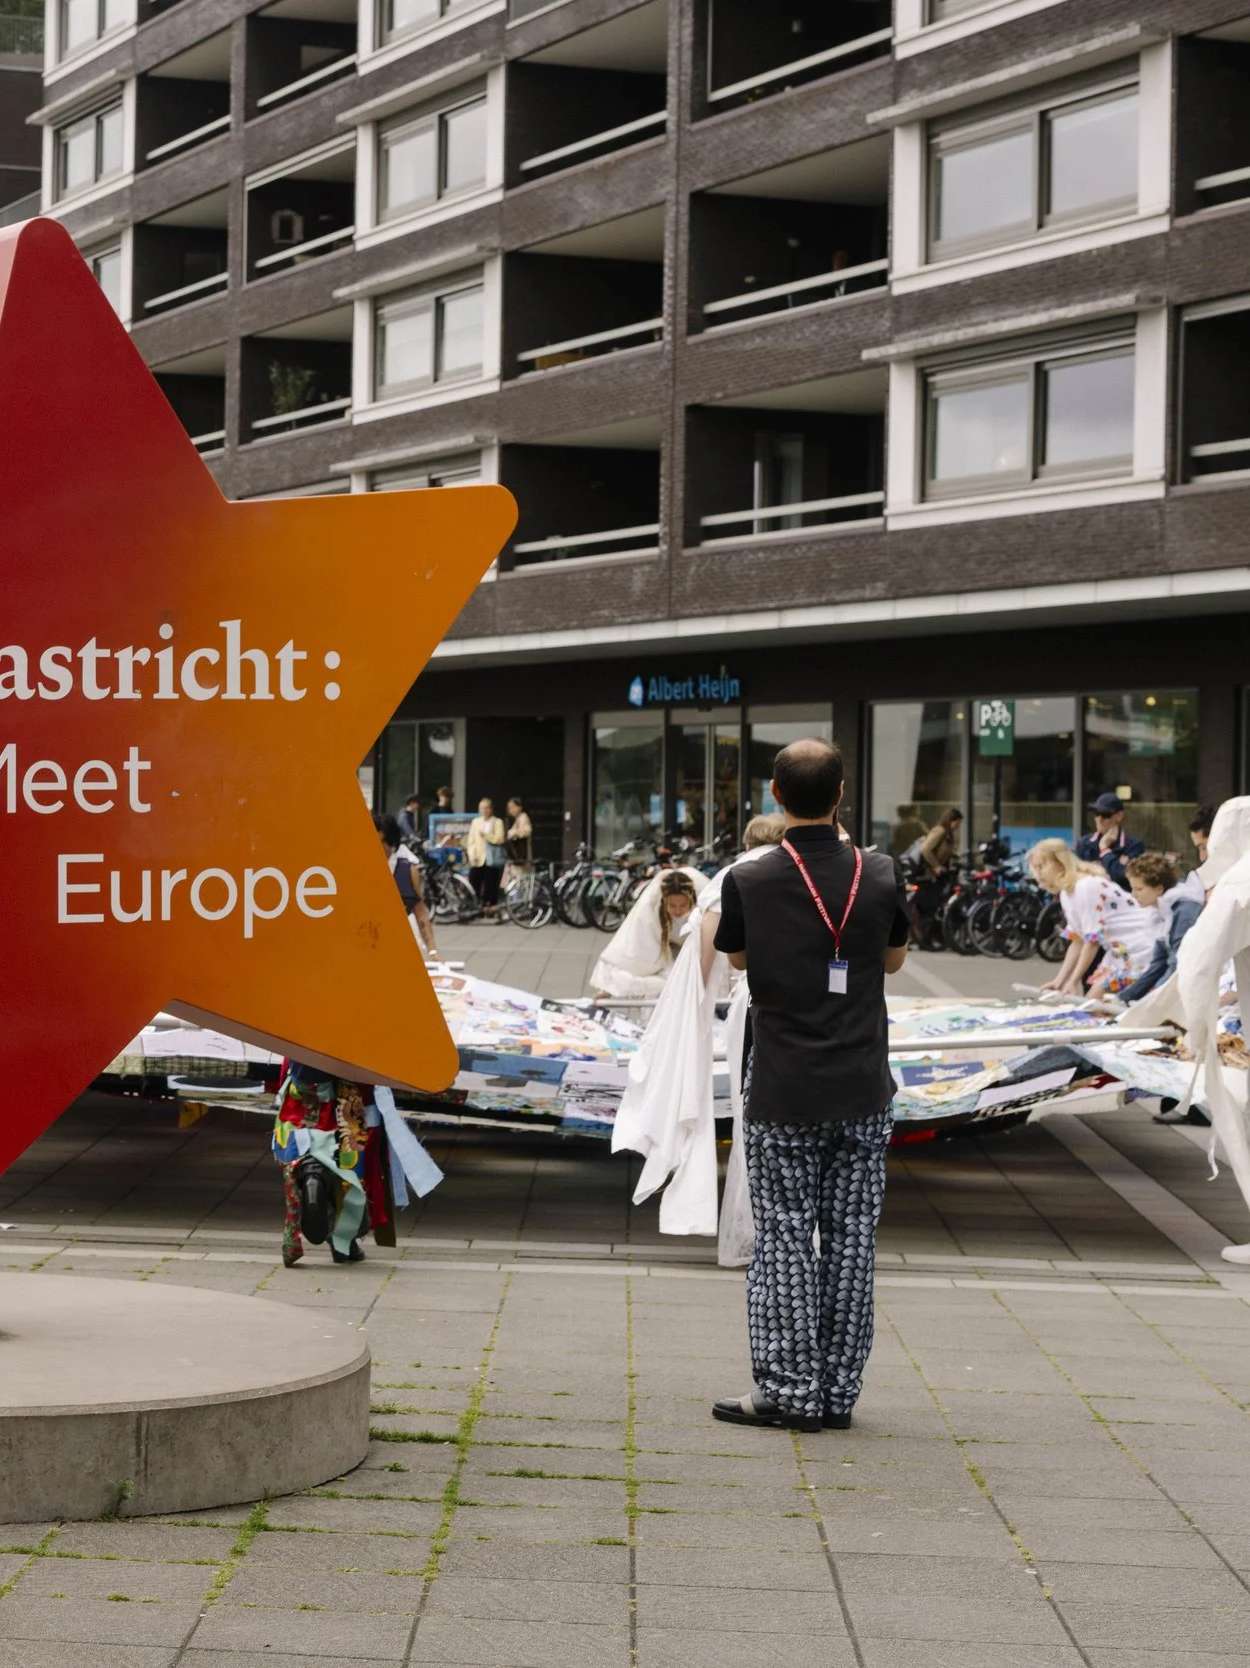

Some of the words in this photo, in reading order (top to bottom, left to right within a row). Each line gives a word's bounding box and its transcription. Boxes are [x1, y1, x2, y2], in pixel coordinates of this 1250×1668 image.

[649, 676, 694, 700] Albert
[698, 674, 739, 704] Heijn
[57, 853, 338, 939] Europe
